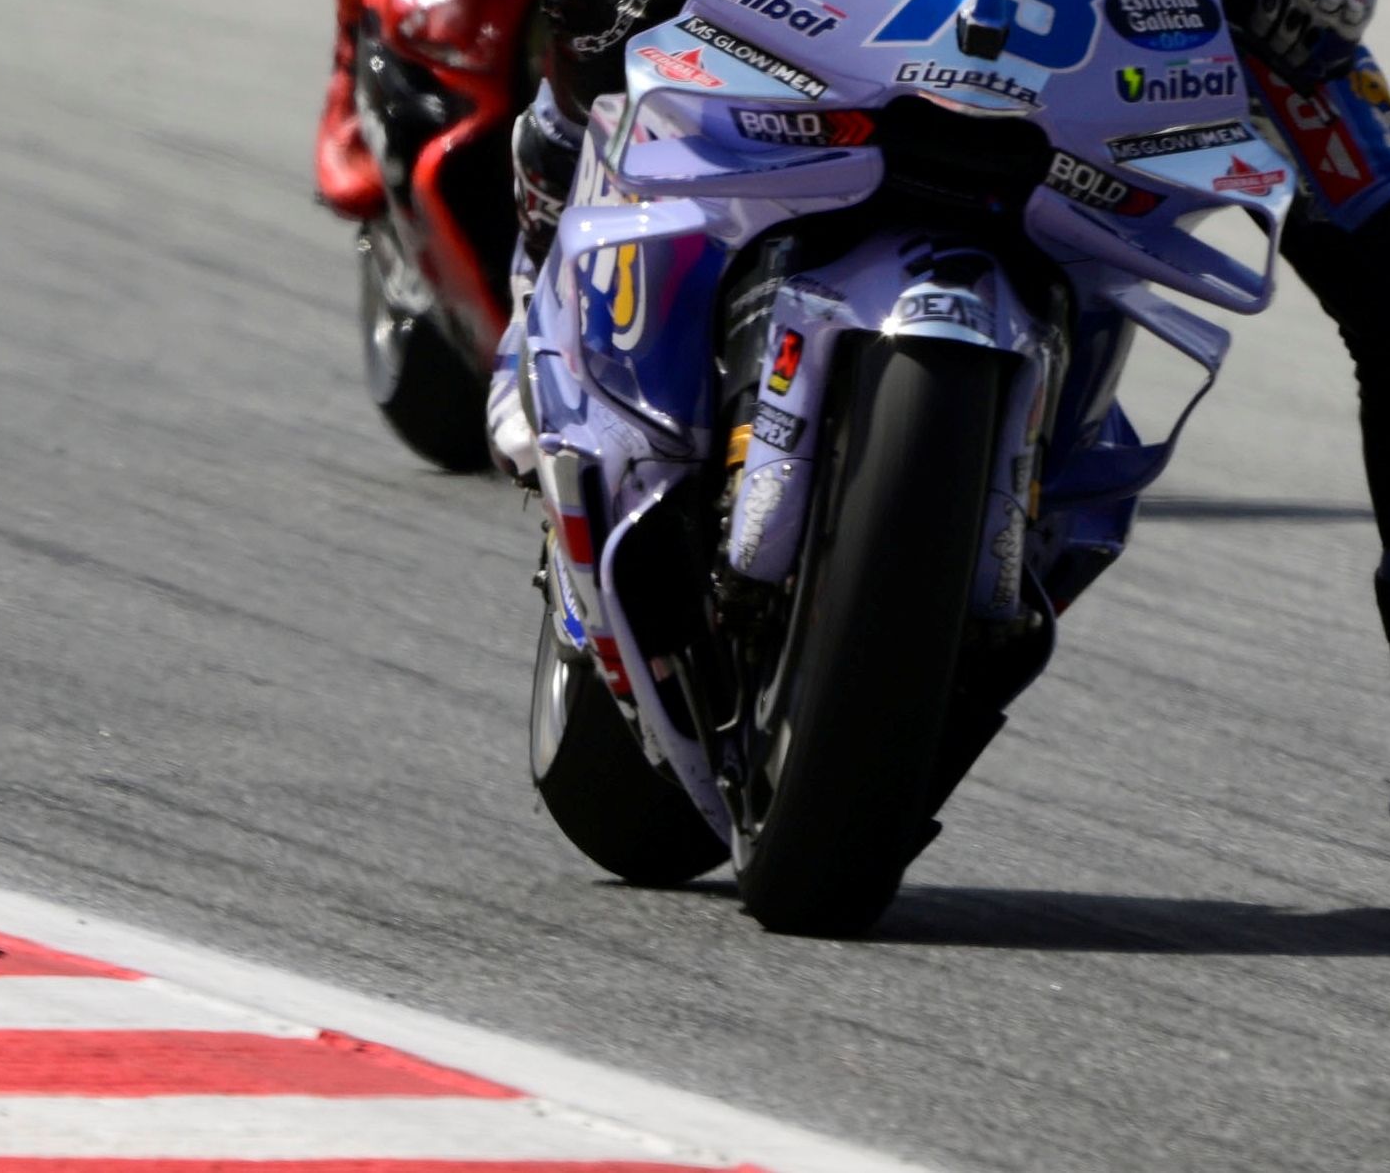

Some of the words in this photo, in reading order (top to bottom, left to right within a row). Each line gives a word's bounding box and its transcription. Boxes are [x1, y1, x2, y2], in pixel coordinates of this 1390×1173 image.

[1127, 11, 1204, 32] Galicia
[713, 34, 772, 71] GLOW
[894, 61, 1044, 108] Gigetta
[1116, 65, 1238, 103] Unibat
[739, 110, 821, 136] BOLD
[1141, 131, 1198, 155] GLOW
[1049, 151, 1128, 204] BOLD
